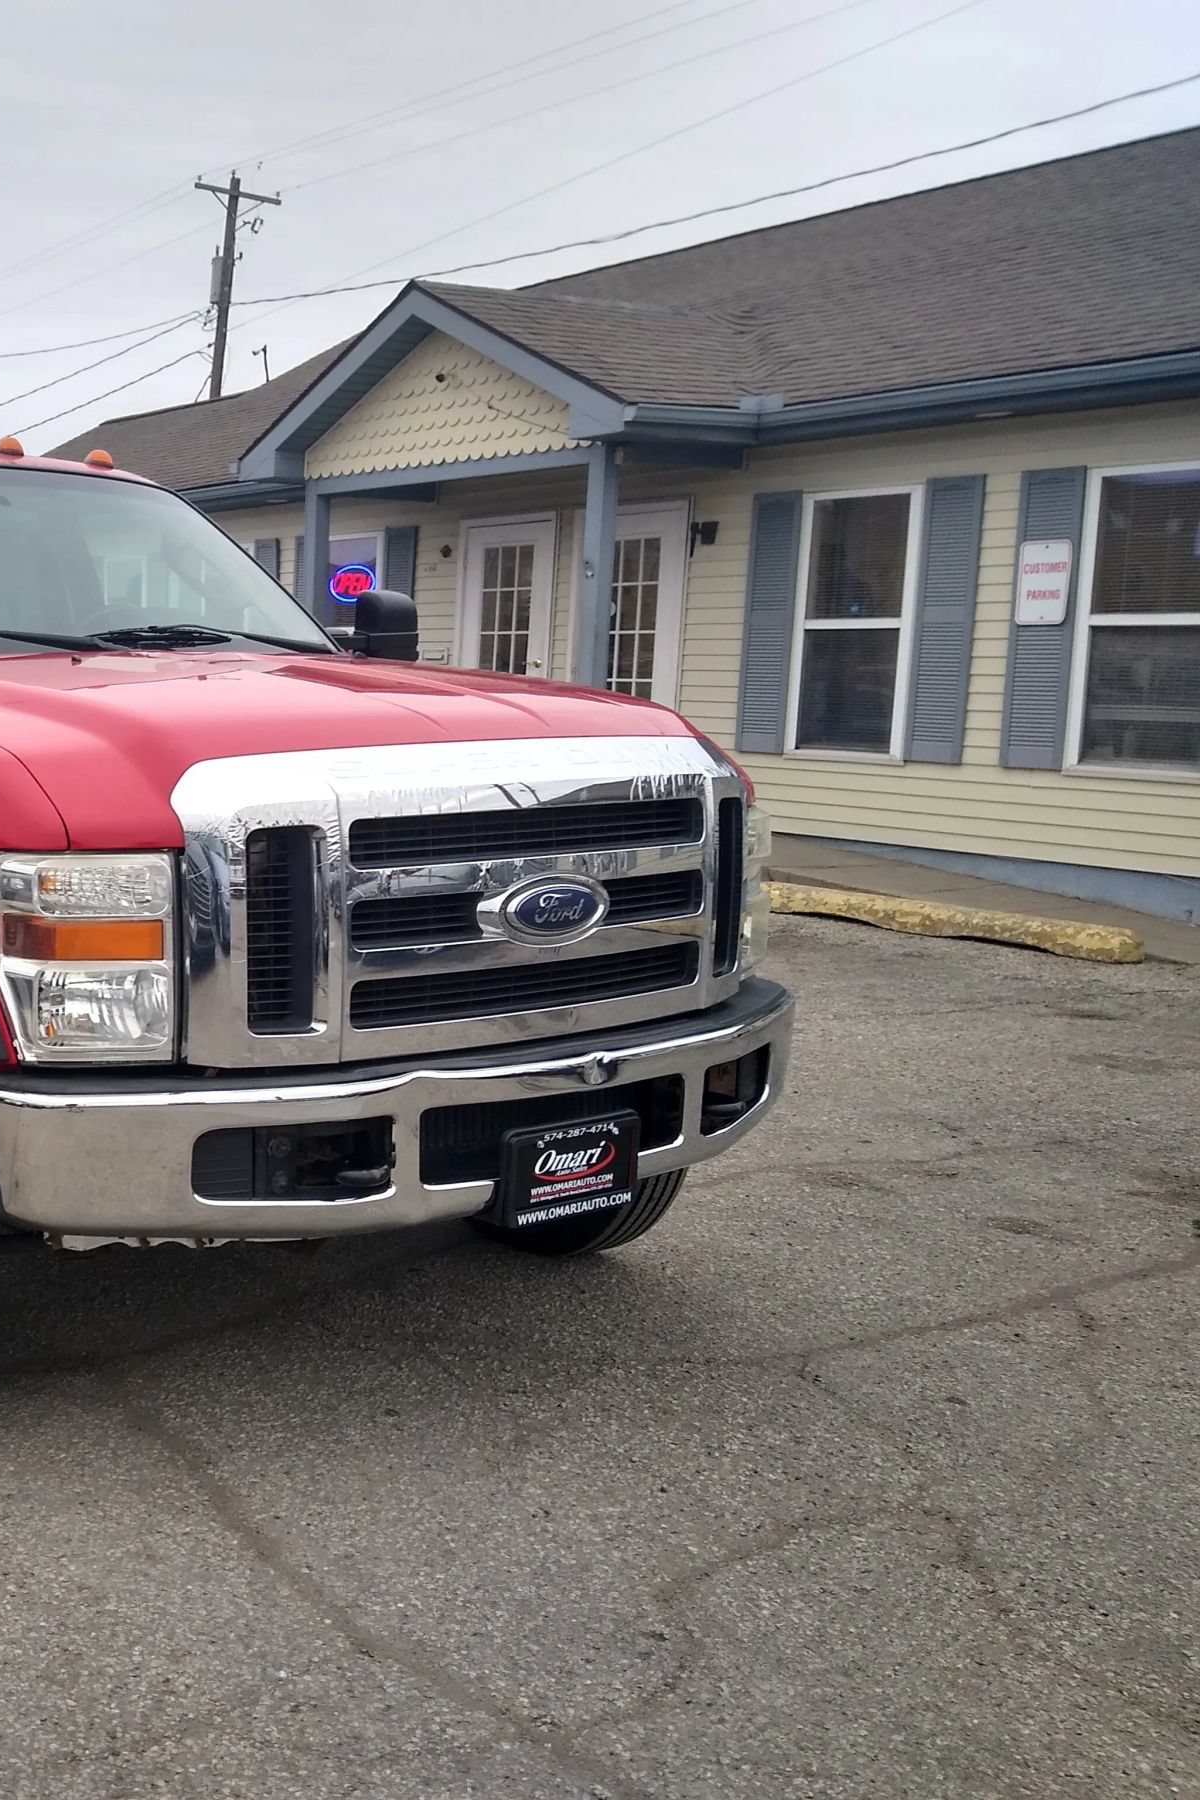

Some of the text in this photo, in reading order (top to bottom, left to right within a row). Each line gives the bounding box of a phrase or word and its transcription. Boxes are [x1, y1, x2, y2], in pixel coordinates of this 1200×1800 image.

[1023, 561, 1068, 575] CUSTOMER
[333, 572, 372, 595] OPEN
[1026, 588, 1060, 600] PARKING
[535, 893, 585, 923] Ford
[543, 1122, 615, 1142] 574-287-4714
[534, 1140, 606, 1175] Omari
[530, 1173, 614, 1196] WWW.OMARIAUTO.COM
[517, 1191, 632, 1226] WWW.OMARIAUTO.COM
